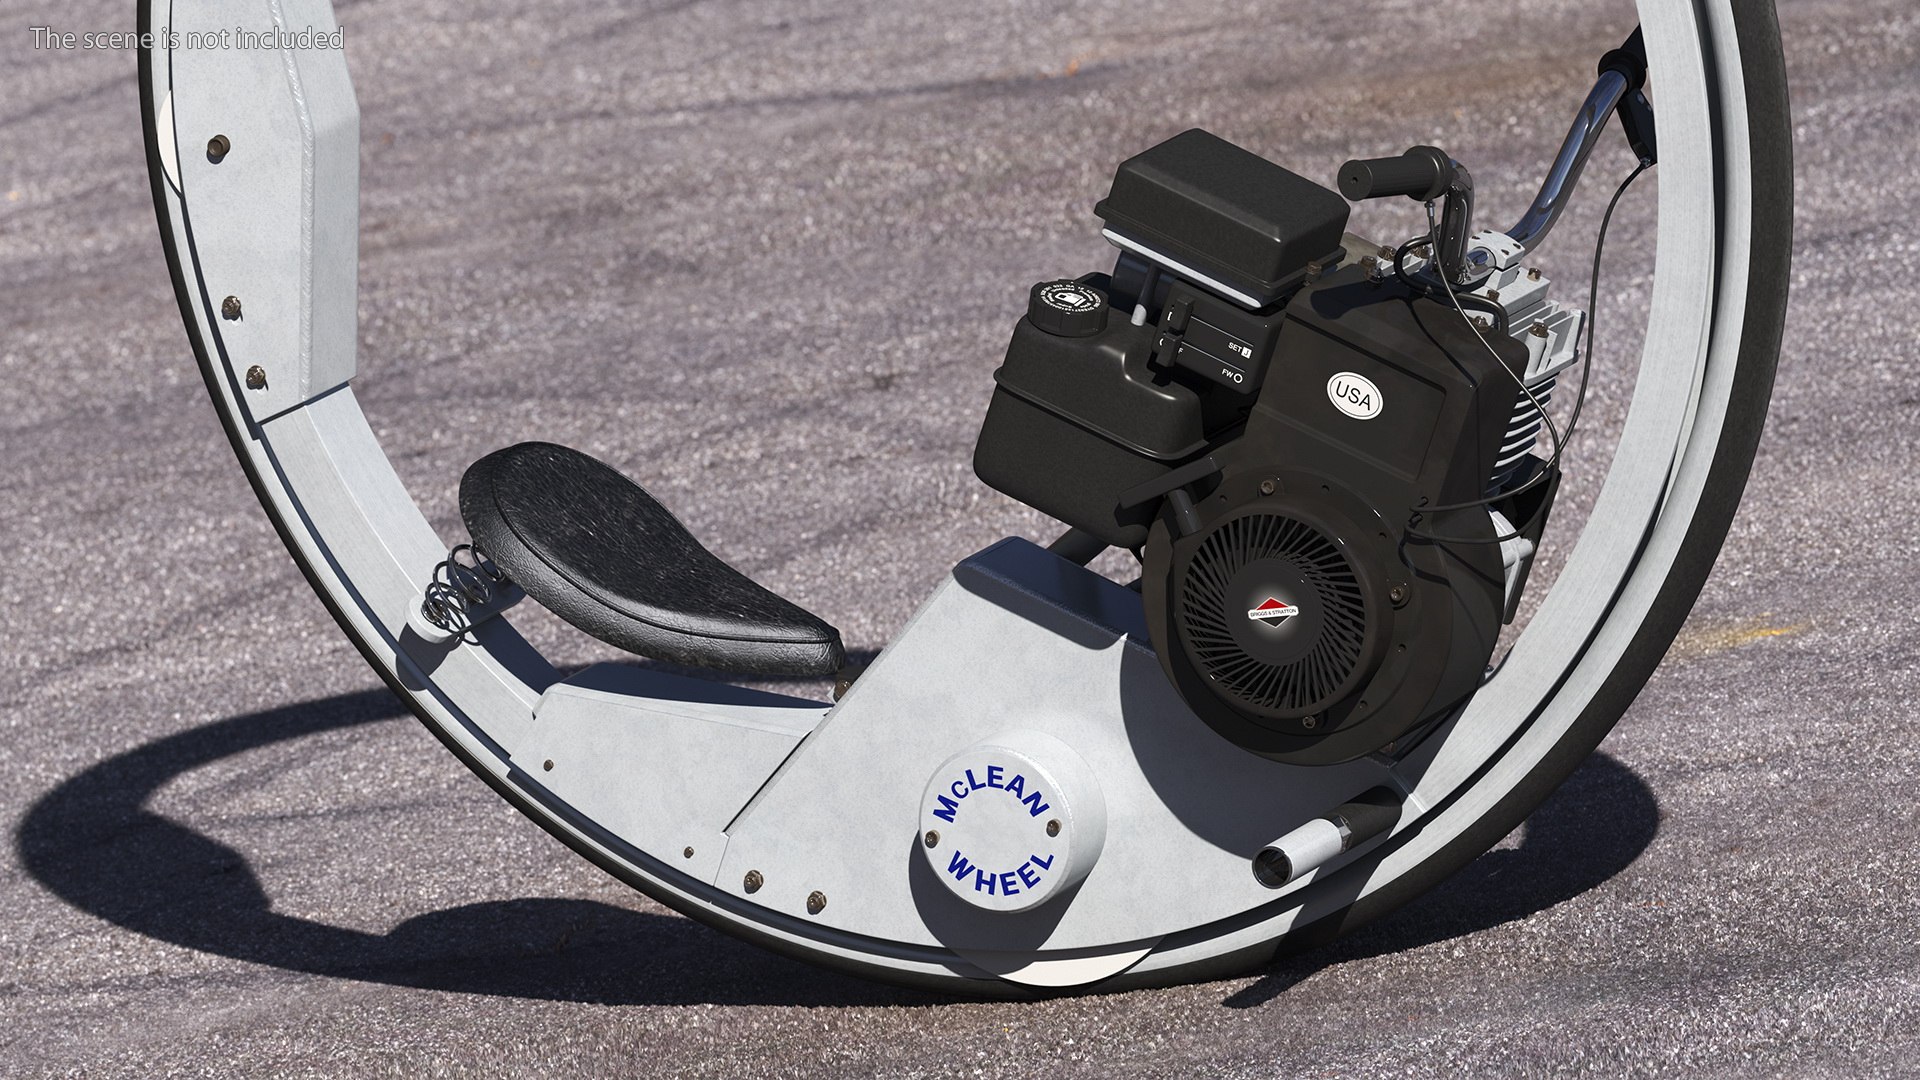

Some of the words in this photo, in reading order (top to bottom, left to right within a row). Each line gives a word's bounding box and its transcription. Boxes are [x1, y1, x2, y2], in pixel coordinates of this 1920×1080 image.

[1228, 342, 1242, 353] SET
[1336, 380, 1370, 411] USA
[1272, 607, 1297, 615] STRATTON
[947, 850, 1054, 896] WHEEL
